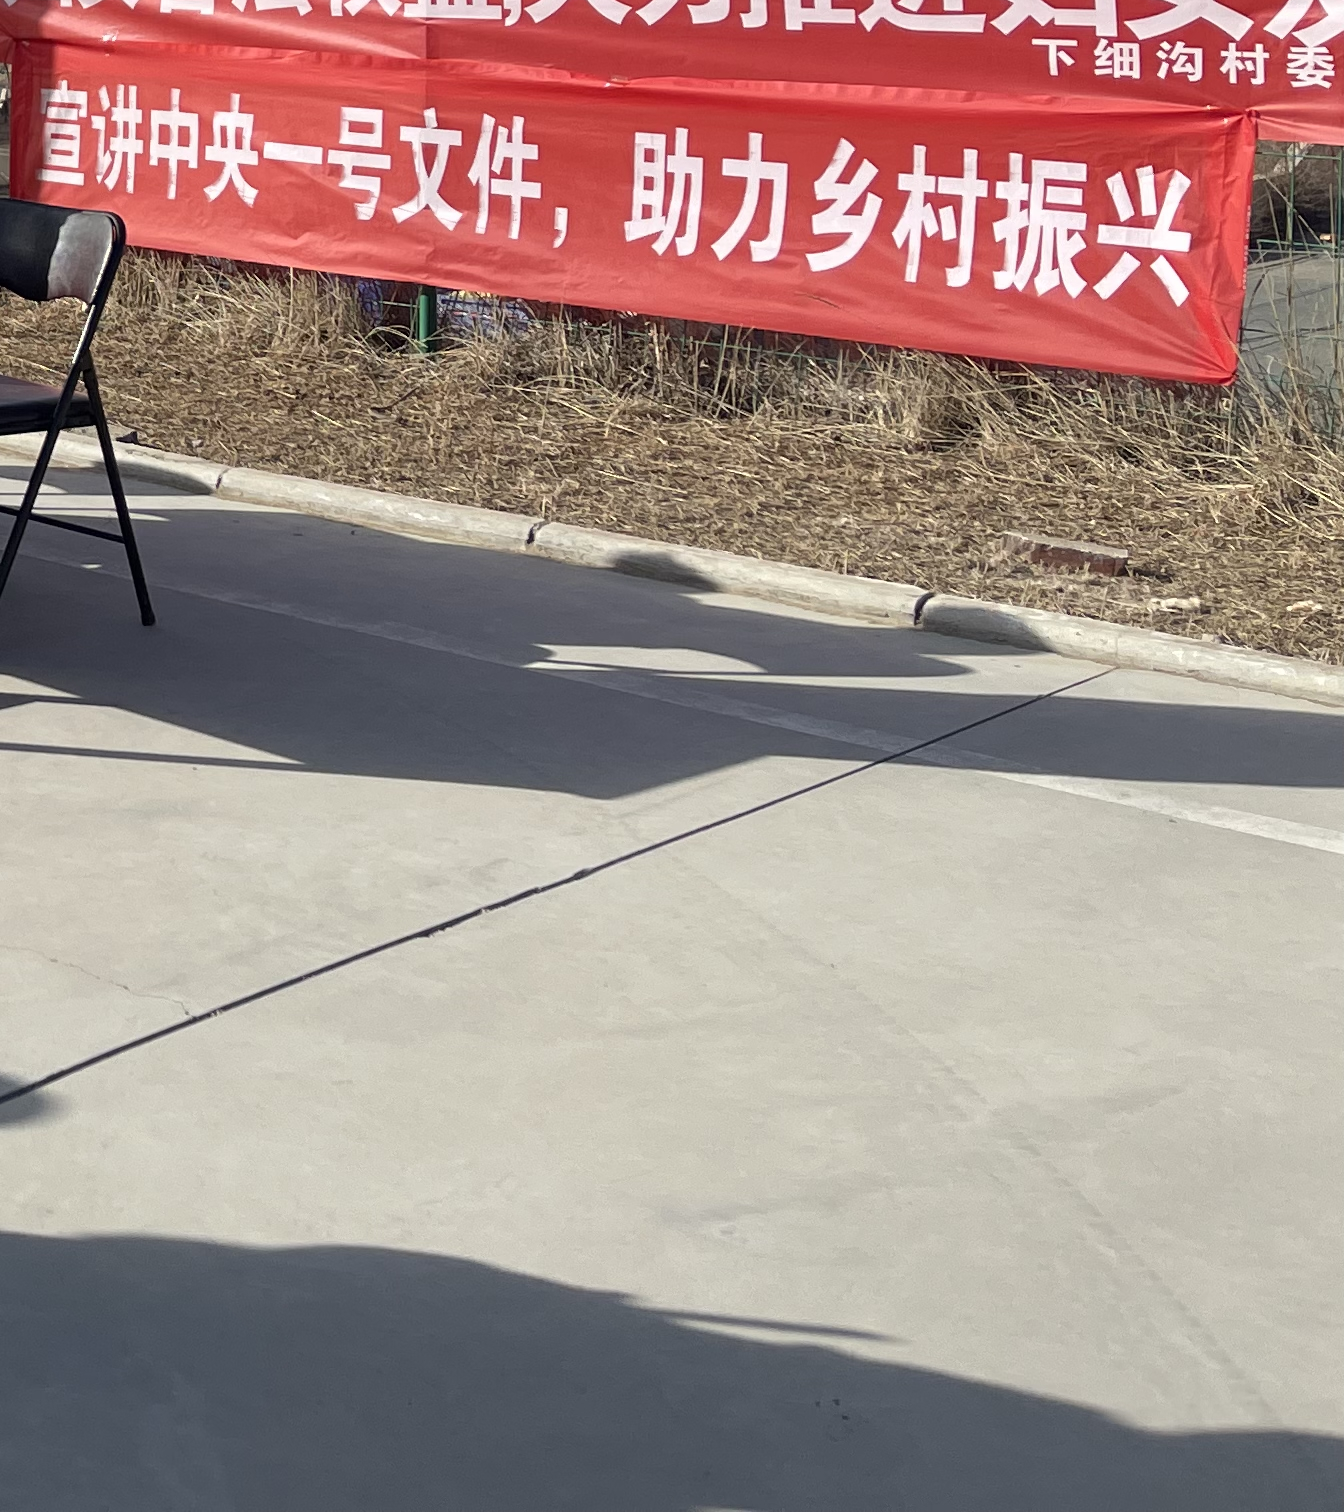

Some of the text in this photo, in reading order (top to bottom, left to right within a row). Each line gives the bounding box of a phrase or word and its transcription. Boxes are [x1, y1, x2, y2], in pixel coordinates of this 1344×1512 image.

[1030, 37, 1336, 89] 下细沟村委
